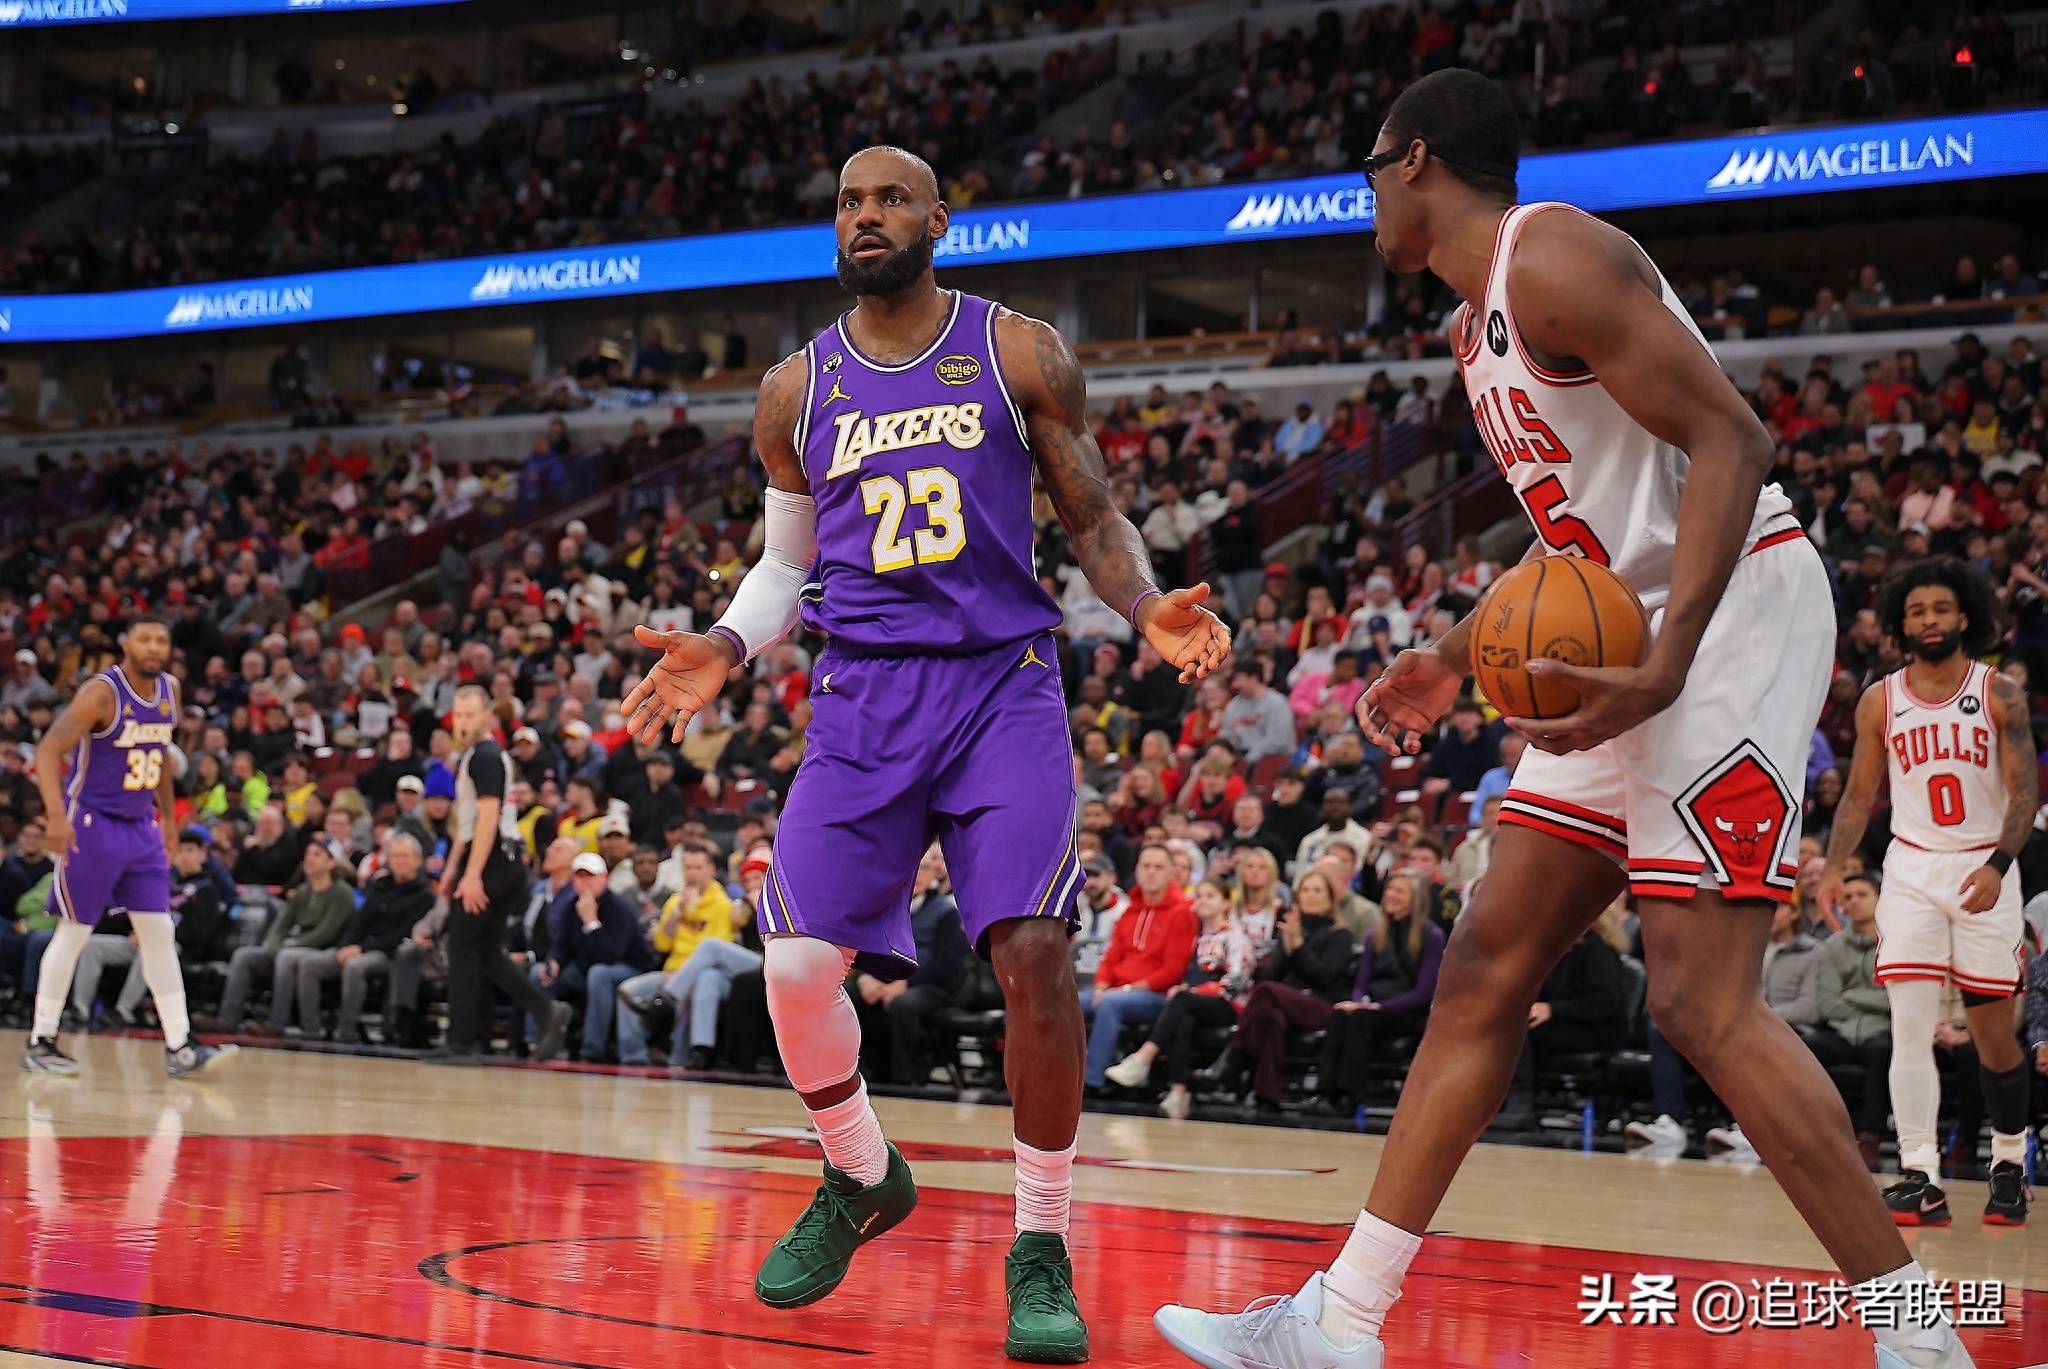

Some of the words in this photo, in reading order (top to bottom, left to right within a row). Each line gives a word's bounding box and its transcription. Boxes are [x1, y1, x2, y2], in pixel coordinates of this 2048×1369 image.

[1773, 132, 1974, 182] MAGELLAN
[1281, 187, 1376, 225] MAGE
[933, 219, 1030, 257] ELLAN
[511, 255, 641, 292] MAGELLAN
[940, 362, 978, 376] bibigo
[826, 402, 986, 481] LAKERS
[859, 465, 968, 574] 23
[123, 749, 163, 790] 36
[1892, 724, 1988, 774] BULLS
[1928, 774, 1965, 826] 0
